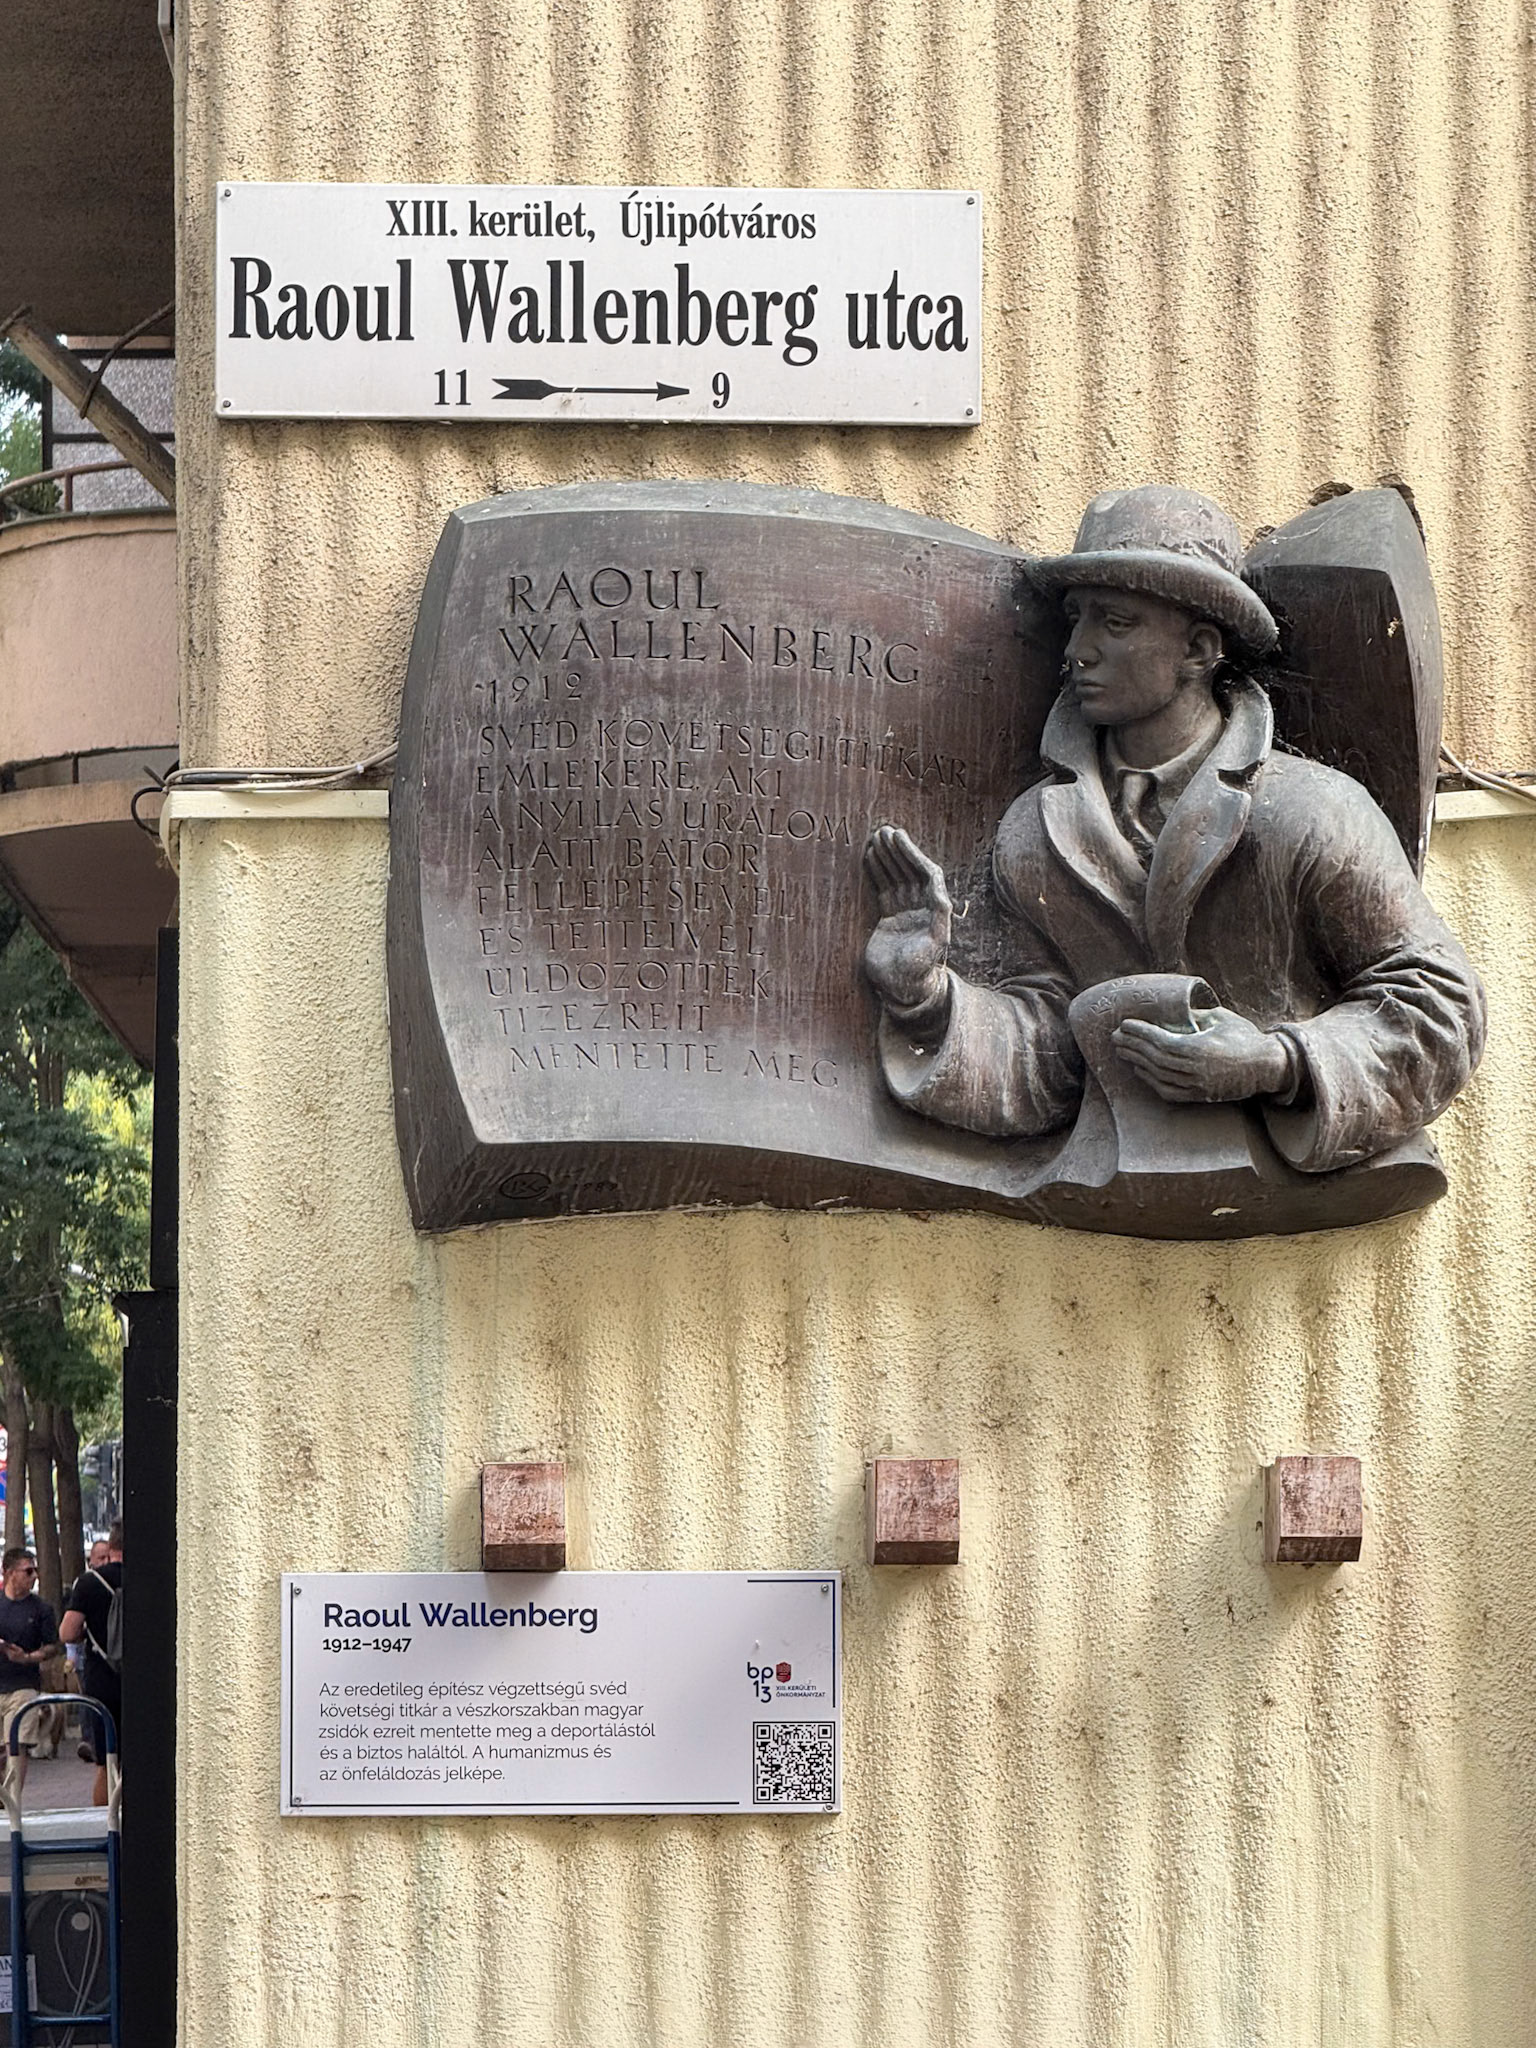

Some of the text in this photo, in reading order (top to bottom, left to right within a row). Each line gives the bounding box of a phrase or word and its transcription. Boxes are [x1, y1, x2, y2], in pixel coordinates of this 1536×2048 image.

[386, 191, 816, 247] XIII. kerület, Újlipótváros
[228, 257, 969, 367] Raoul Wallenberg utca
[434, 369, 730, 409] 11 9
[510, 567, 721, 617] RAOUL
[499, 620, 919, 684] WALLENBERG
[713, 765, 782, 800] AKI
[474, 799, 851, 847] A NYILAS URALOM
[474, 838, 601, 876] ALATT
[480, 919, 765, 957] ÉS TETTEIVEL
[509, 1041, 839, 1089] MENTETTE MEG
[324, 1601, 598, 1634] Raoul Wallenberg
[319, 1680, 627, 1700] Az eredetileg építész végzettségű svéd
[746, 1661, 774, 1684] bp
[752, 1680, 772, 1703] 13
[320, 1702, 644, 1721] követségi titkár a vészkorszakban magyar
[318, 1722, 656, 1742] zsidók ezreit mentette meg a deportálástól
[319, 1744, 612, 1760] és a biztos haláltól. A humanizmus és
[319, 1766, 506, 1784] az önfeláldozás jelképe.
